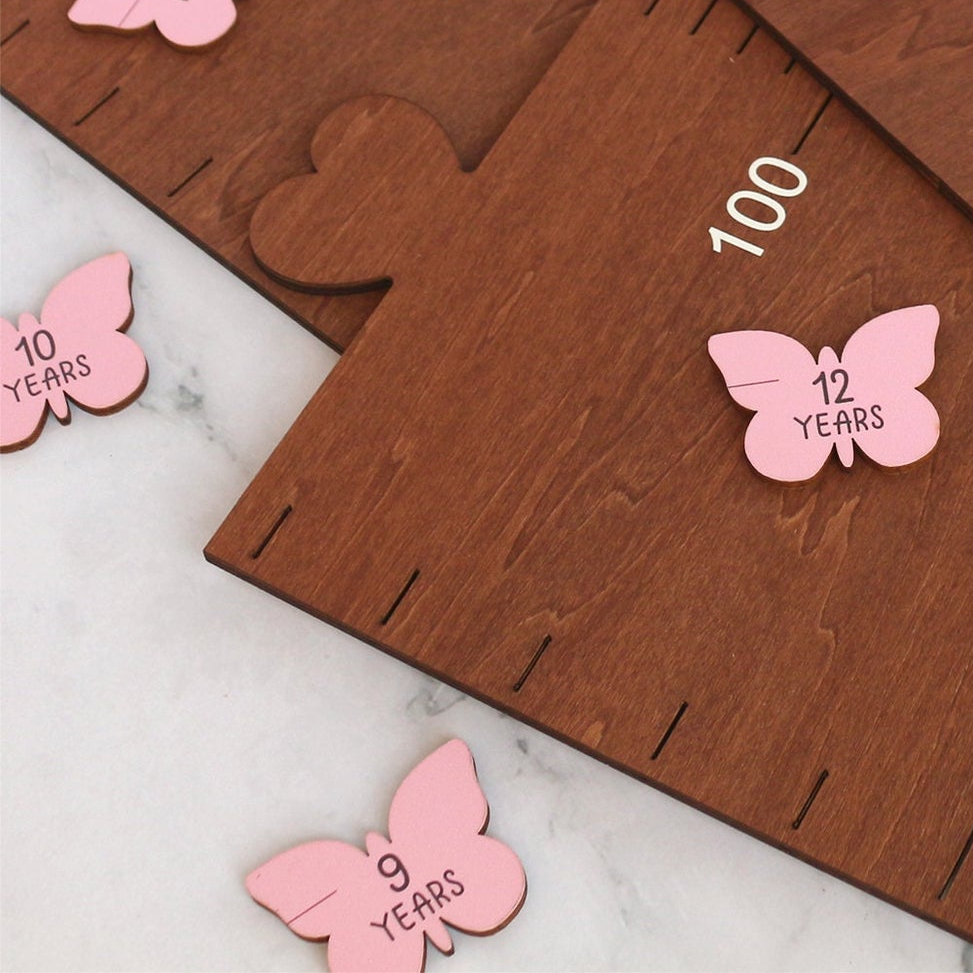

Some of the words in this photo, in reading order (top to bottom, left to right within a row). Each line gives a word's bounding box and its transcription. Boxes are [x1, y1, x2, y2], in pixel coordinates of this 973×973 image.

[708, 156, 808, 257] 100
[14, 329, 56, 367] 10
[2, 353, 92, 403] YEARS
[811, 368, 855, 406] 12
[792, 403, 885, 440] YEARS
[376, 852, 411, 893] 9
[369, 869, 465, 943] YEARS
